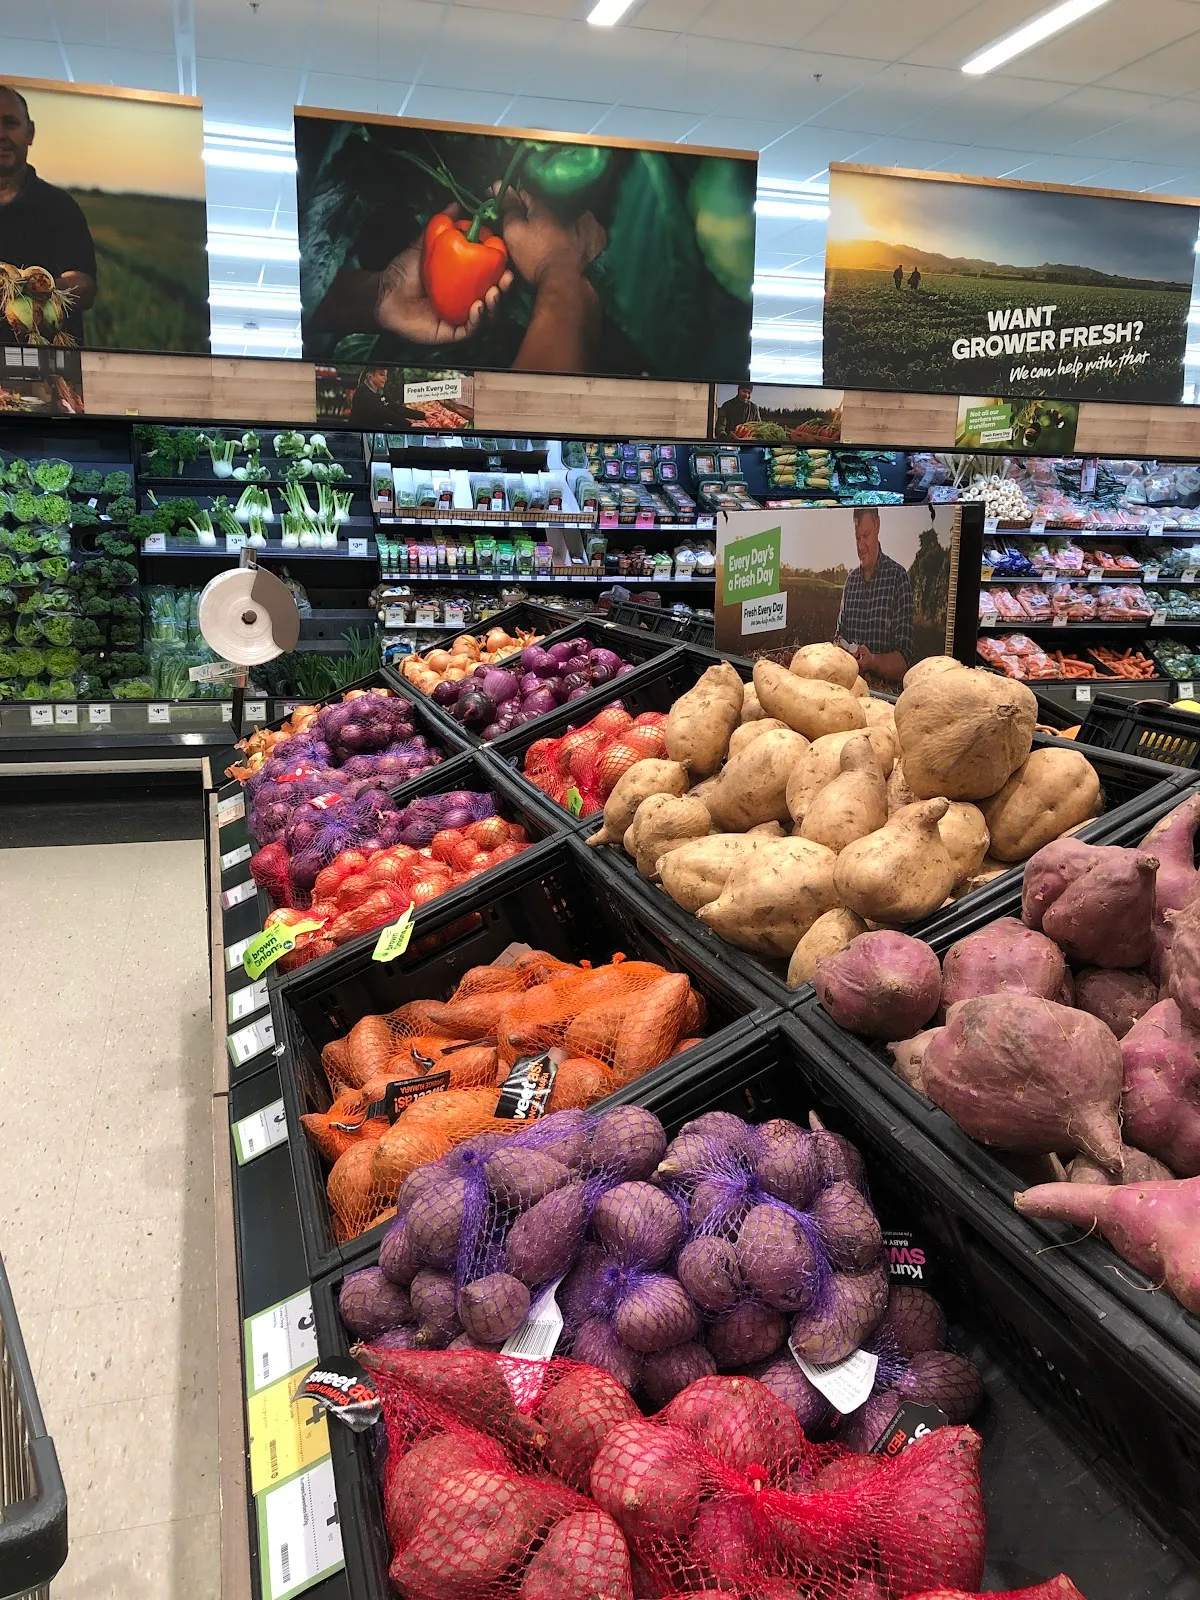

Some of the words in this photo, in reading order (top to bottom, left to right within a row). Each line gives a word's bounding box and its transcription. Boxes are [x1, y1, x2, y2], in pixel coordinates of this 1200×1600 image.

[988, 305, 1057, 332] WANT
[952, 330, 1055, 360] GROWER
[1060, 320, 1144, 351] FRESH?
[1010, 365, 1030, 383] We
[1030, 366, 1056, 380] can
[1057, 358, 1083, 381] help
[1085, 354, 1116, 373] with
[1116, 346, 1150, 365] that
[407, 386, 425, 394] Fresh
[445, 383, 458, 391] Day
[728, 553, 751, 572] Every
[751, 544, 775, 568] Day's
[728, 579, 733, 591] a
[734, 569, 756, 590] Fresh
[756, 567, 774, 587] Day
[743, 606, 757, 619] Fresh
[758, 604, 772, 617] Every
[772, 602, 784, 614] Day
[251, 936, 277, 960] brown
[304, 1369, 357, 1393] sweet
[317, 1385, 350, 1406] KUMARA
[886, 1429, 907, 1454] RED
